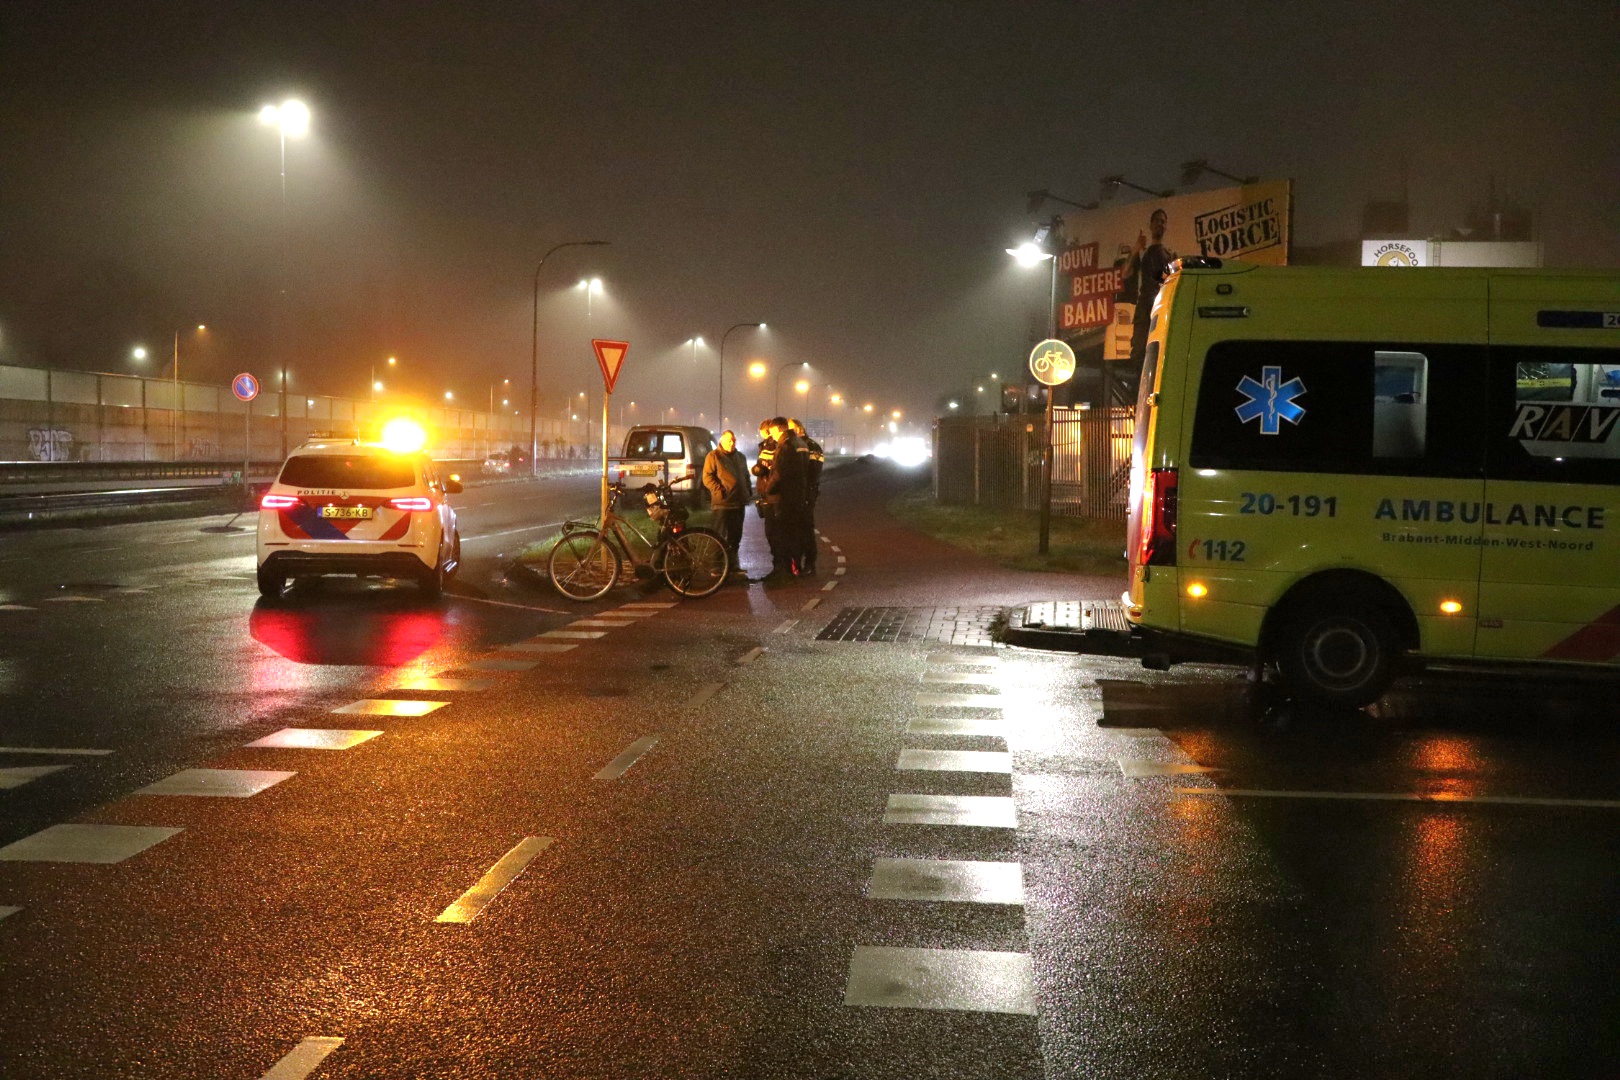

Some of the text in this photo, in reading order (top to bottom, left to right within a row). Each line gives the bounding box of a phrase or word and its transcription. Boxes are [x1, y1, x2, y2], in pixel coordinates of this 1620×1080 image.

[1199, 199, 1274, 237] LOGISTIC
[1200, 217, 1278, 257] FORCE
[1073, 269, 1121, 297] BETERE
[1064, 298, 1107, 327] BAAN
[1508, 405, 1620, 440] RAV
[1240, 492, 1337, 517] 20-191
[1374, 498, 1604, 529] AMBULANCE
